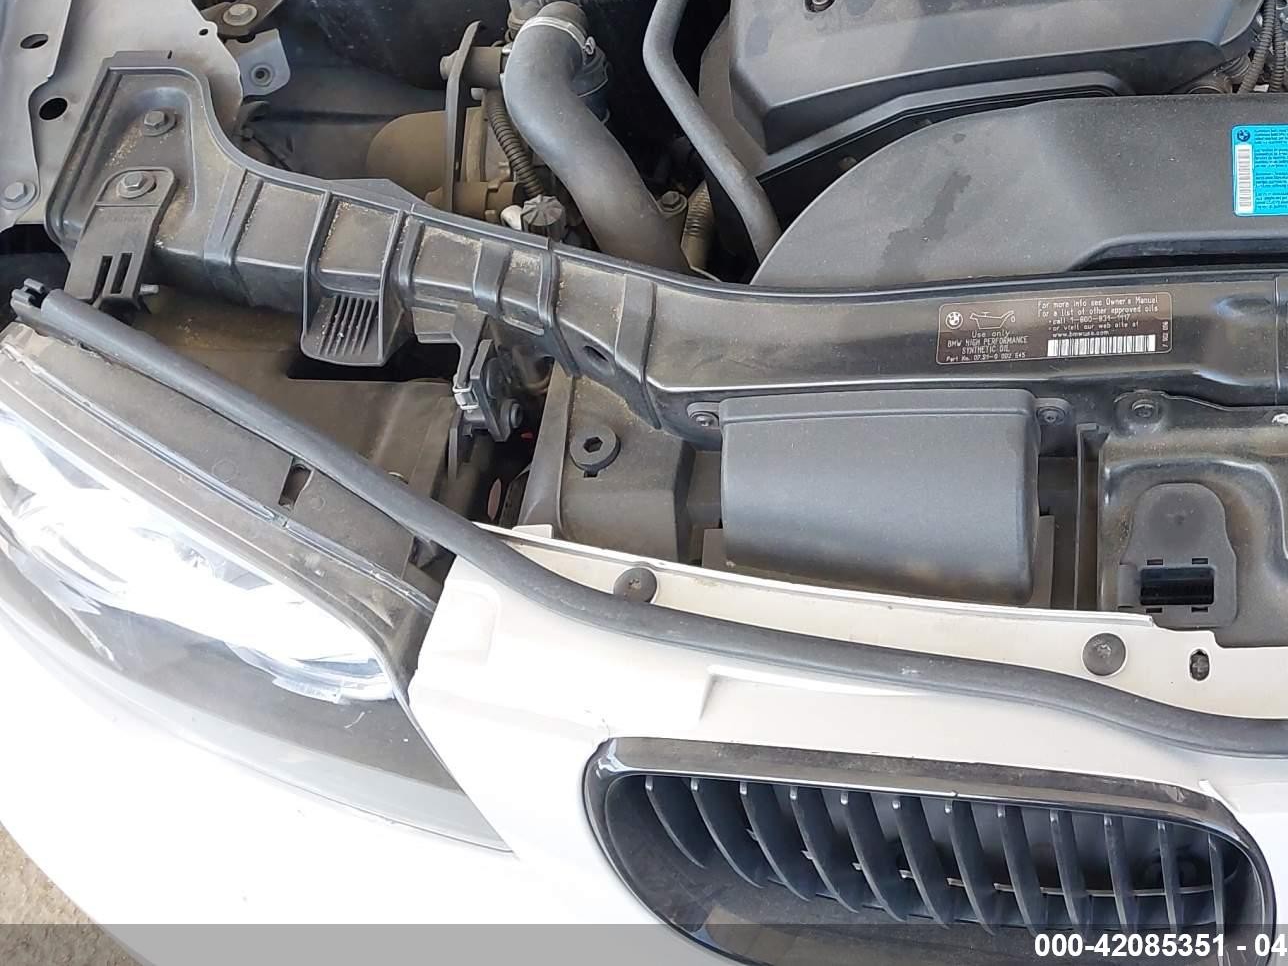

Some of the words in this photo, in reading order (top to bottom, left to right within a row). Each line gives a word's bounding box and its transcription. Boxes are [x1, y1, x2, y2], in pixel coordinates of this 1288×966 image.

[1106, 297, 1131, 305] Owner's
[1136, 295, 1158, 304] Manual
[1111, 305, 1141, 314] approved
[992, 330, 1009, 338] only
[983, 336, 1028, 345] PERFORMANCE
[962, 346, 996, 355] SYNTHETIC
